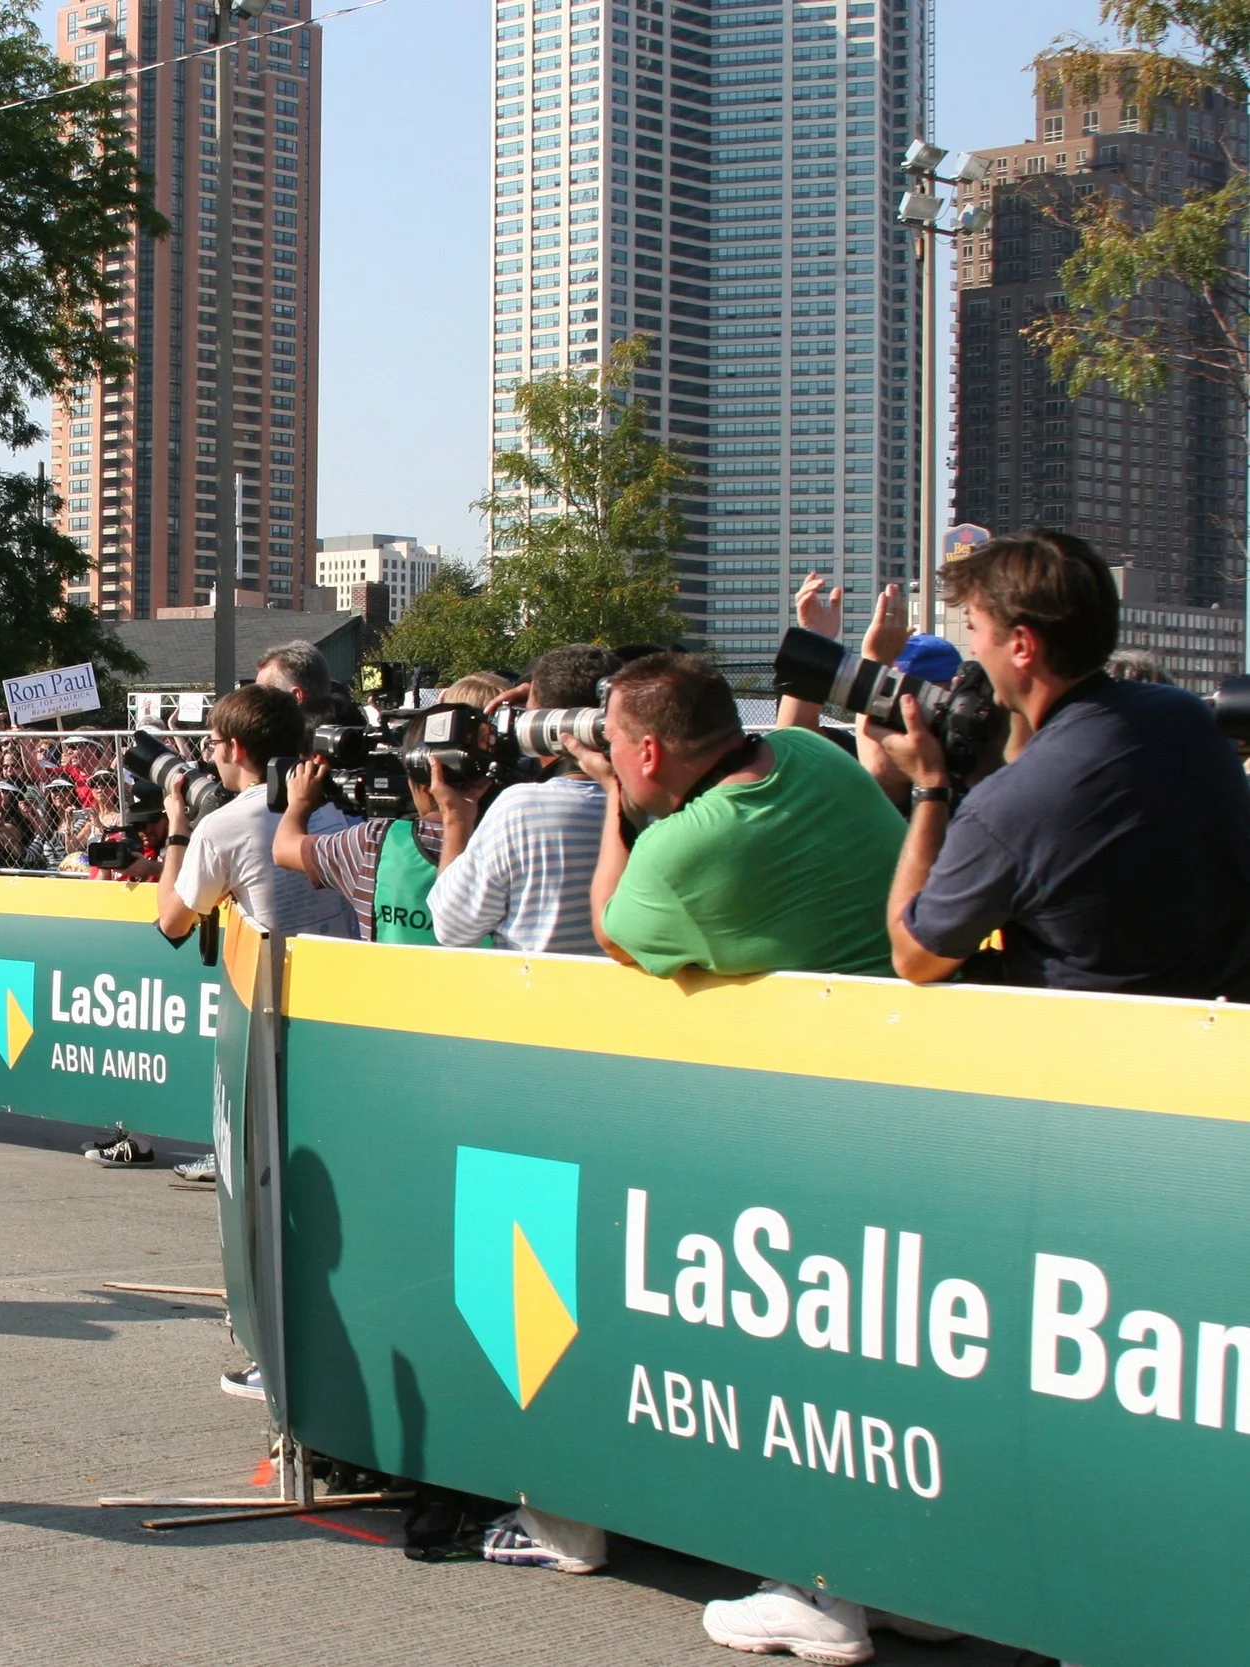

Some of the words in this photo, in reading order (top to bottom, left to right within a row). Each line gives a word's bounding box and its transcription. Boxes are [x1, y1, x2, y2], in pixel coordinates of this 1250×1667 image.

[7, 682, 46, 703] Ron
[50, 667, 94, 694] Paul
[52, 970, 186, 1034] LaSalle
[51, 1043, 95, 1075] ABN
[102, 1049, 167, 1084] AMRO
[624, 1188, 990, 1380] LaSalle
[1029, 1252, 1250, 1435] Ban
[627, 1364, 740, 1451] ABN
[762, 1395, 942, 1500] AMRO
